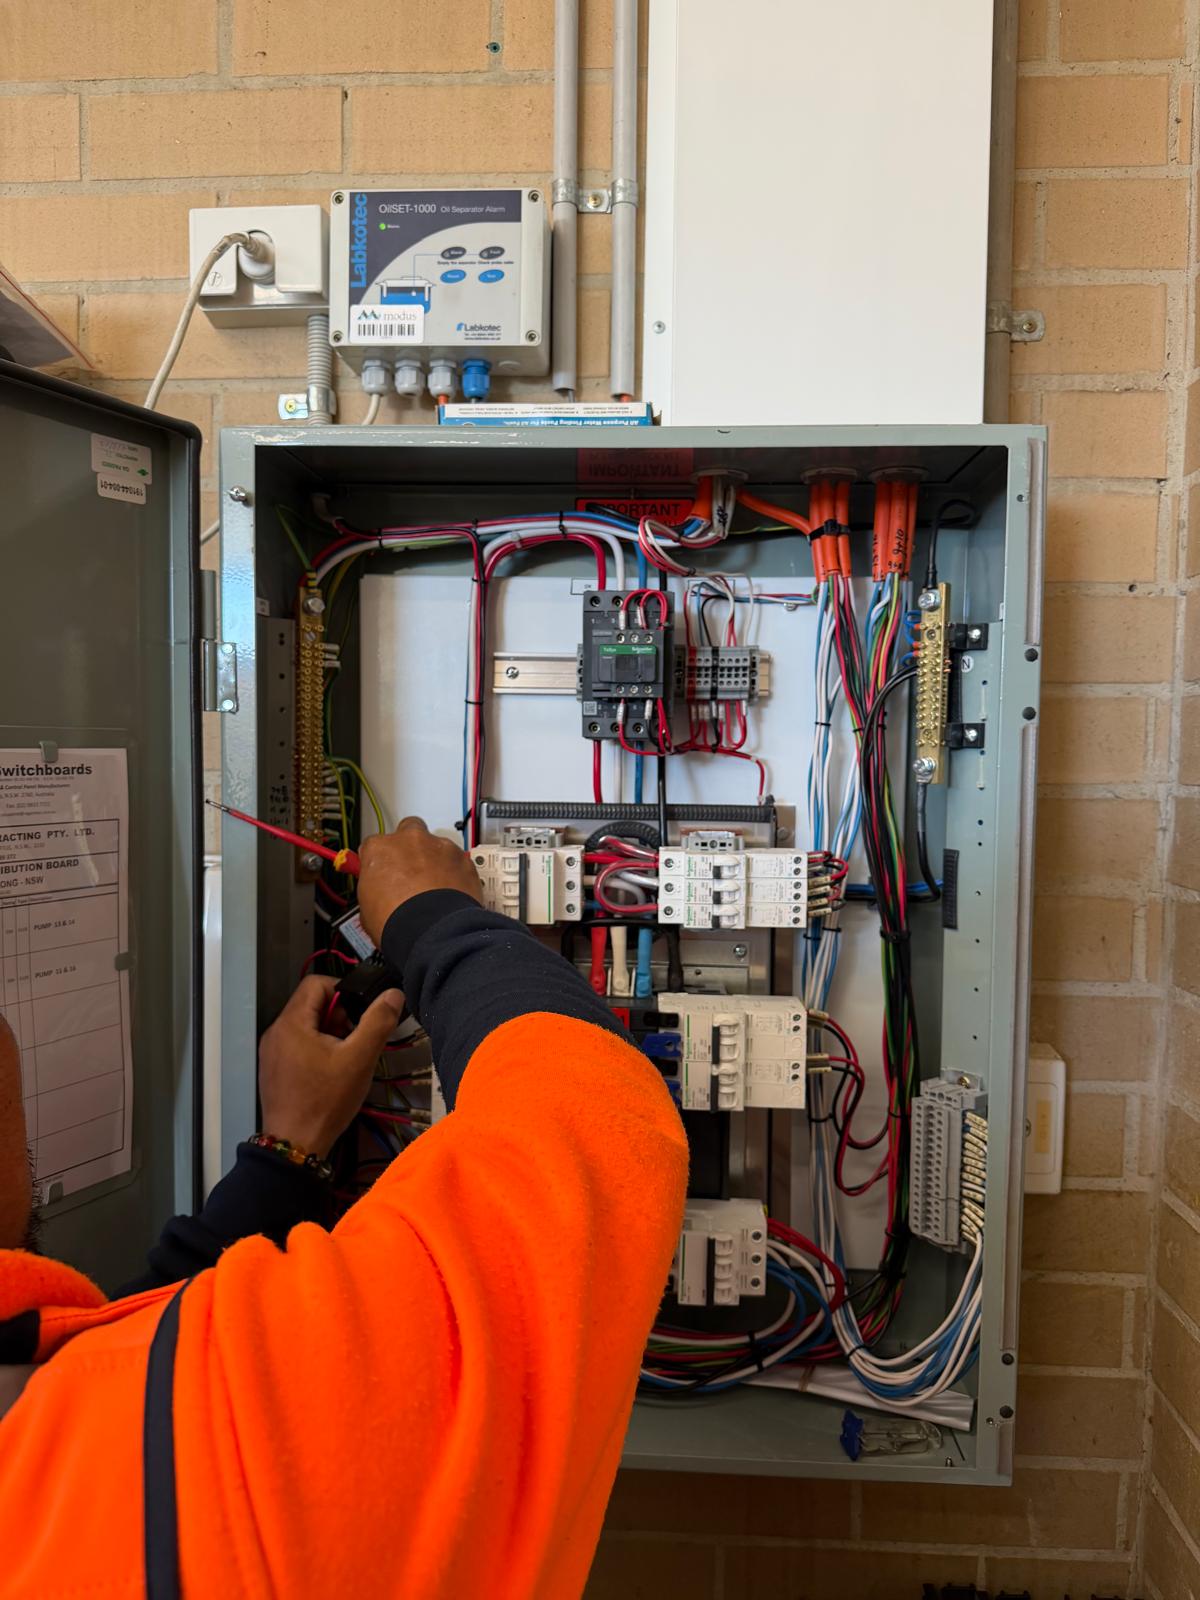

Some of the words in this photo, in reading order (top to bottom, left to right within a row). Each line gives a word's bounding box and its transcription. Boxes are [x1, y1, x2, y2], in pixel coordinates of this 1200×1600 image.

[379, 204, 437, 214] OilSET-1000
[451, 206, 484, 214] Separator
[351, 193, 367, 288] Labkotec
[604, 503, 681, 517] PORTANT
[962, 658, 971, 670] N
[47, 829, 69, 839] PTY.
[74, 828, 95, 837] LTD.
[46, 859, 79, 870] BOARD
[25, 876, 44, 886] NSW
[33, 922, 52, 930] PUMP
[34, 970, 53, 978] PUMP
